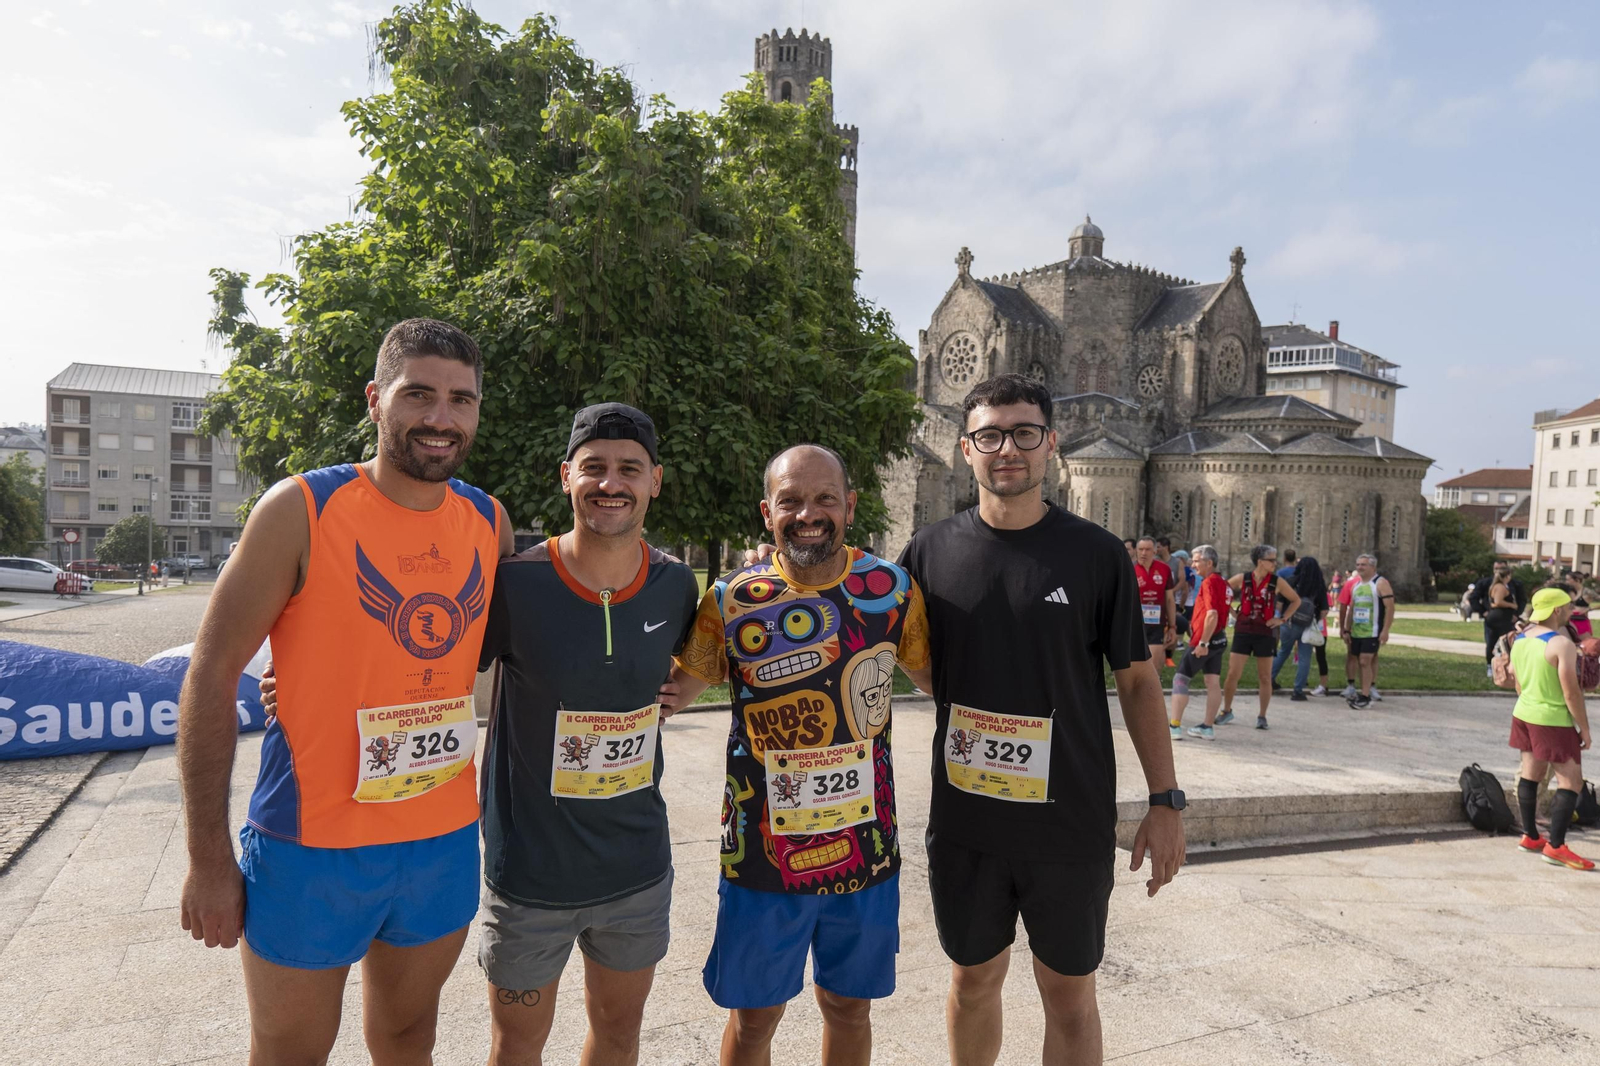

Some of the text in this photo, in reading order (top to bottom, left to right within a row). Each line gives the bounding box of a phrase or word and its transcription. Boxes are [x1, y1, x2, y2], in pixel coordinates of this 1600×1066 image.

[399, 556, 453, 575] BANDE
[421, 594, 454, 611] POPULAR
[368, 700, 465, 722] II CARREIRA POPULAR
[398, 713, 443, 728] DO PULPO
[566, 708, 653, 724] II CARREIRA POPULAR
[749, 697, 825, 736] NO BAD
[962, 710, 1000, 724] CARREIRA
[1001, 718, 1043, 729] POPULAR
[593, 722, 636, 732] DO PULPO
[975, 721, 987, 730] DO
[988, 725, 1018, 735] PULPO
[411, 729, 460, 759] 326
[604, 734, 645, 761] 327
[779, 751, 825, 761] CARREIRA
[827, 743, 865, 756] POPULAR
[984, 739, 1032, 764] 329
[798, 757, 843, 769] DO PULPO
[813, 769, 859, 796] 328
